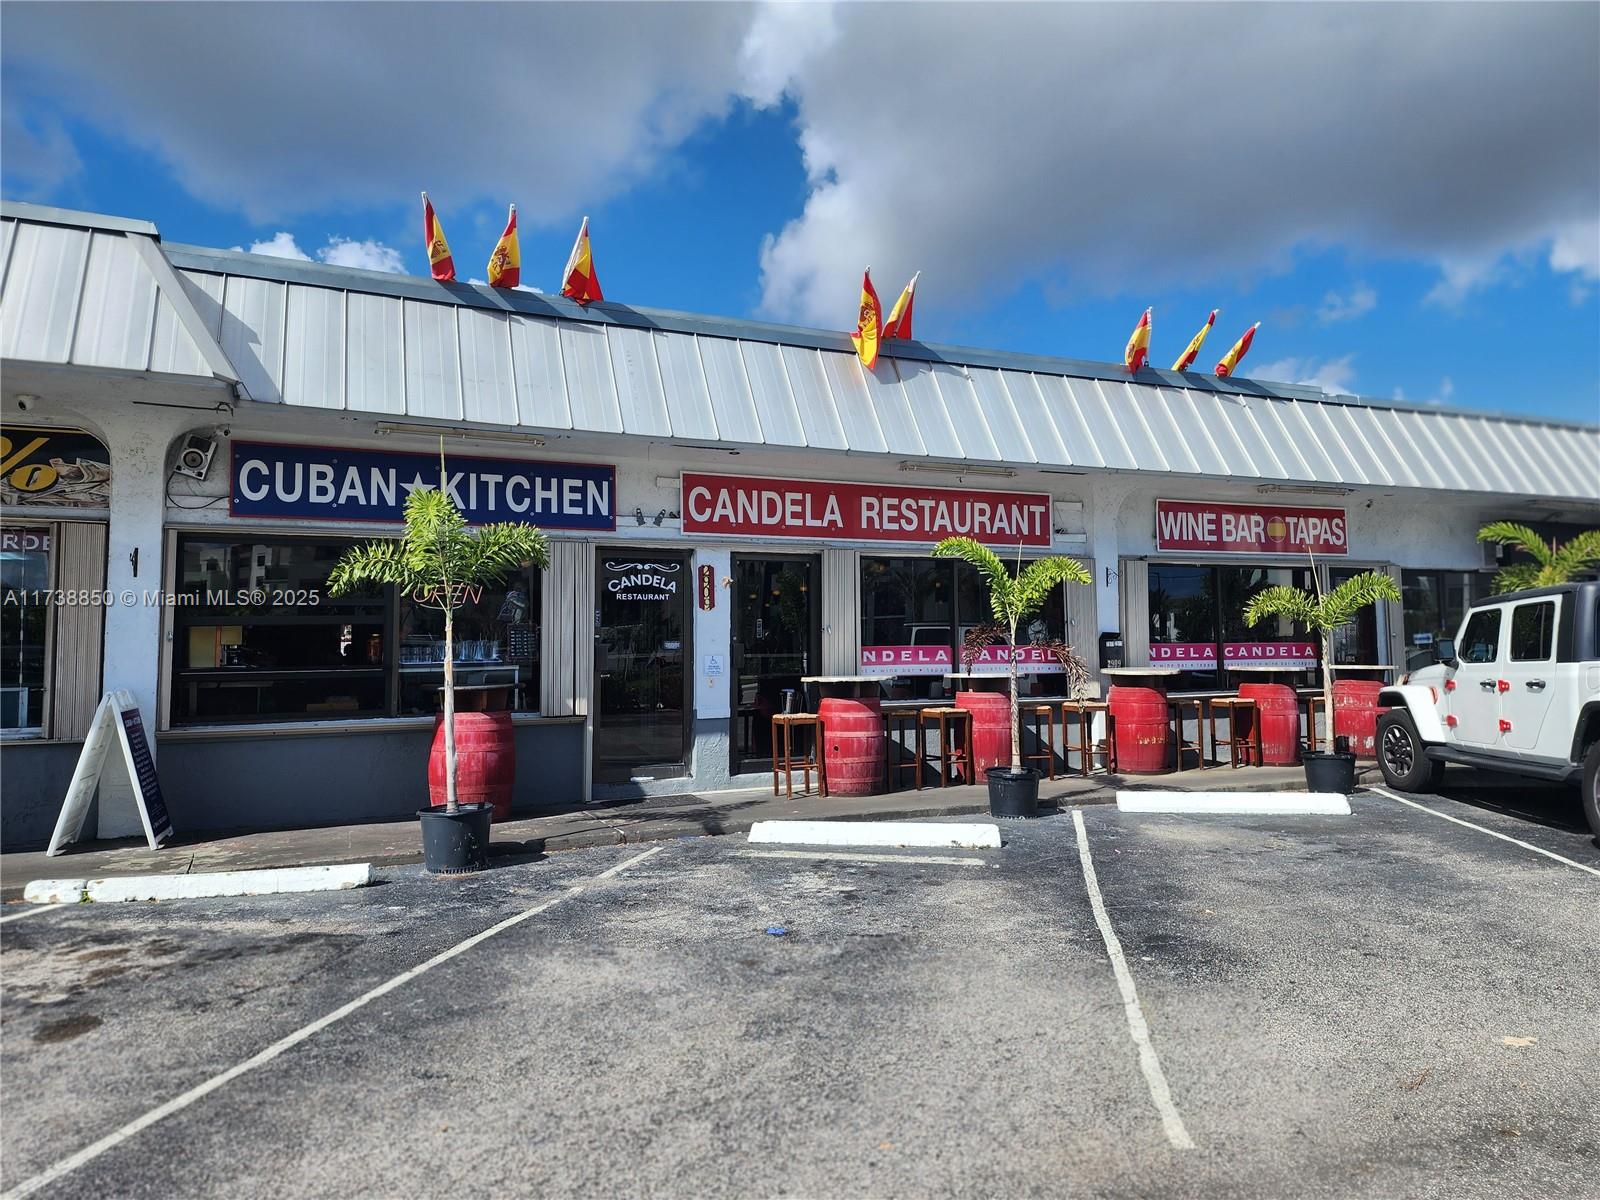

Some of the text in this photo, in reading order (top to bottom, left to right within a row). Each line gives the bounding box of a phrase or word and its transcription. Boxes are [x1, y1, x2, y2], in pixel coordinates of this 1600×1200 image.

[239, 459, 609, 516] CUBAN KITCHEN
[688, 486, 1045, 536] CANDELA RESTAURANT
[1160, 511, 1344, 546] WINE BAR TAPAS
[608, 574, 677, 593] CANDELA
[1224, 647, 1314, 656] CANDELA
